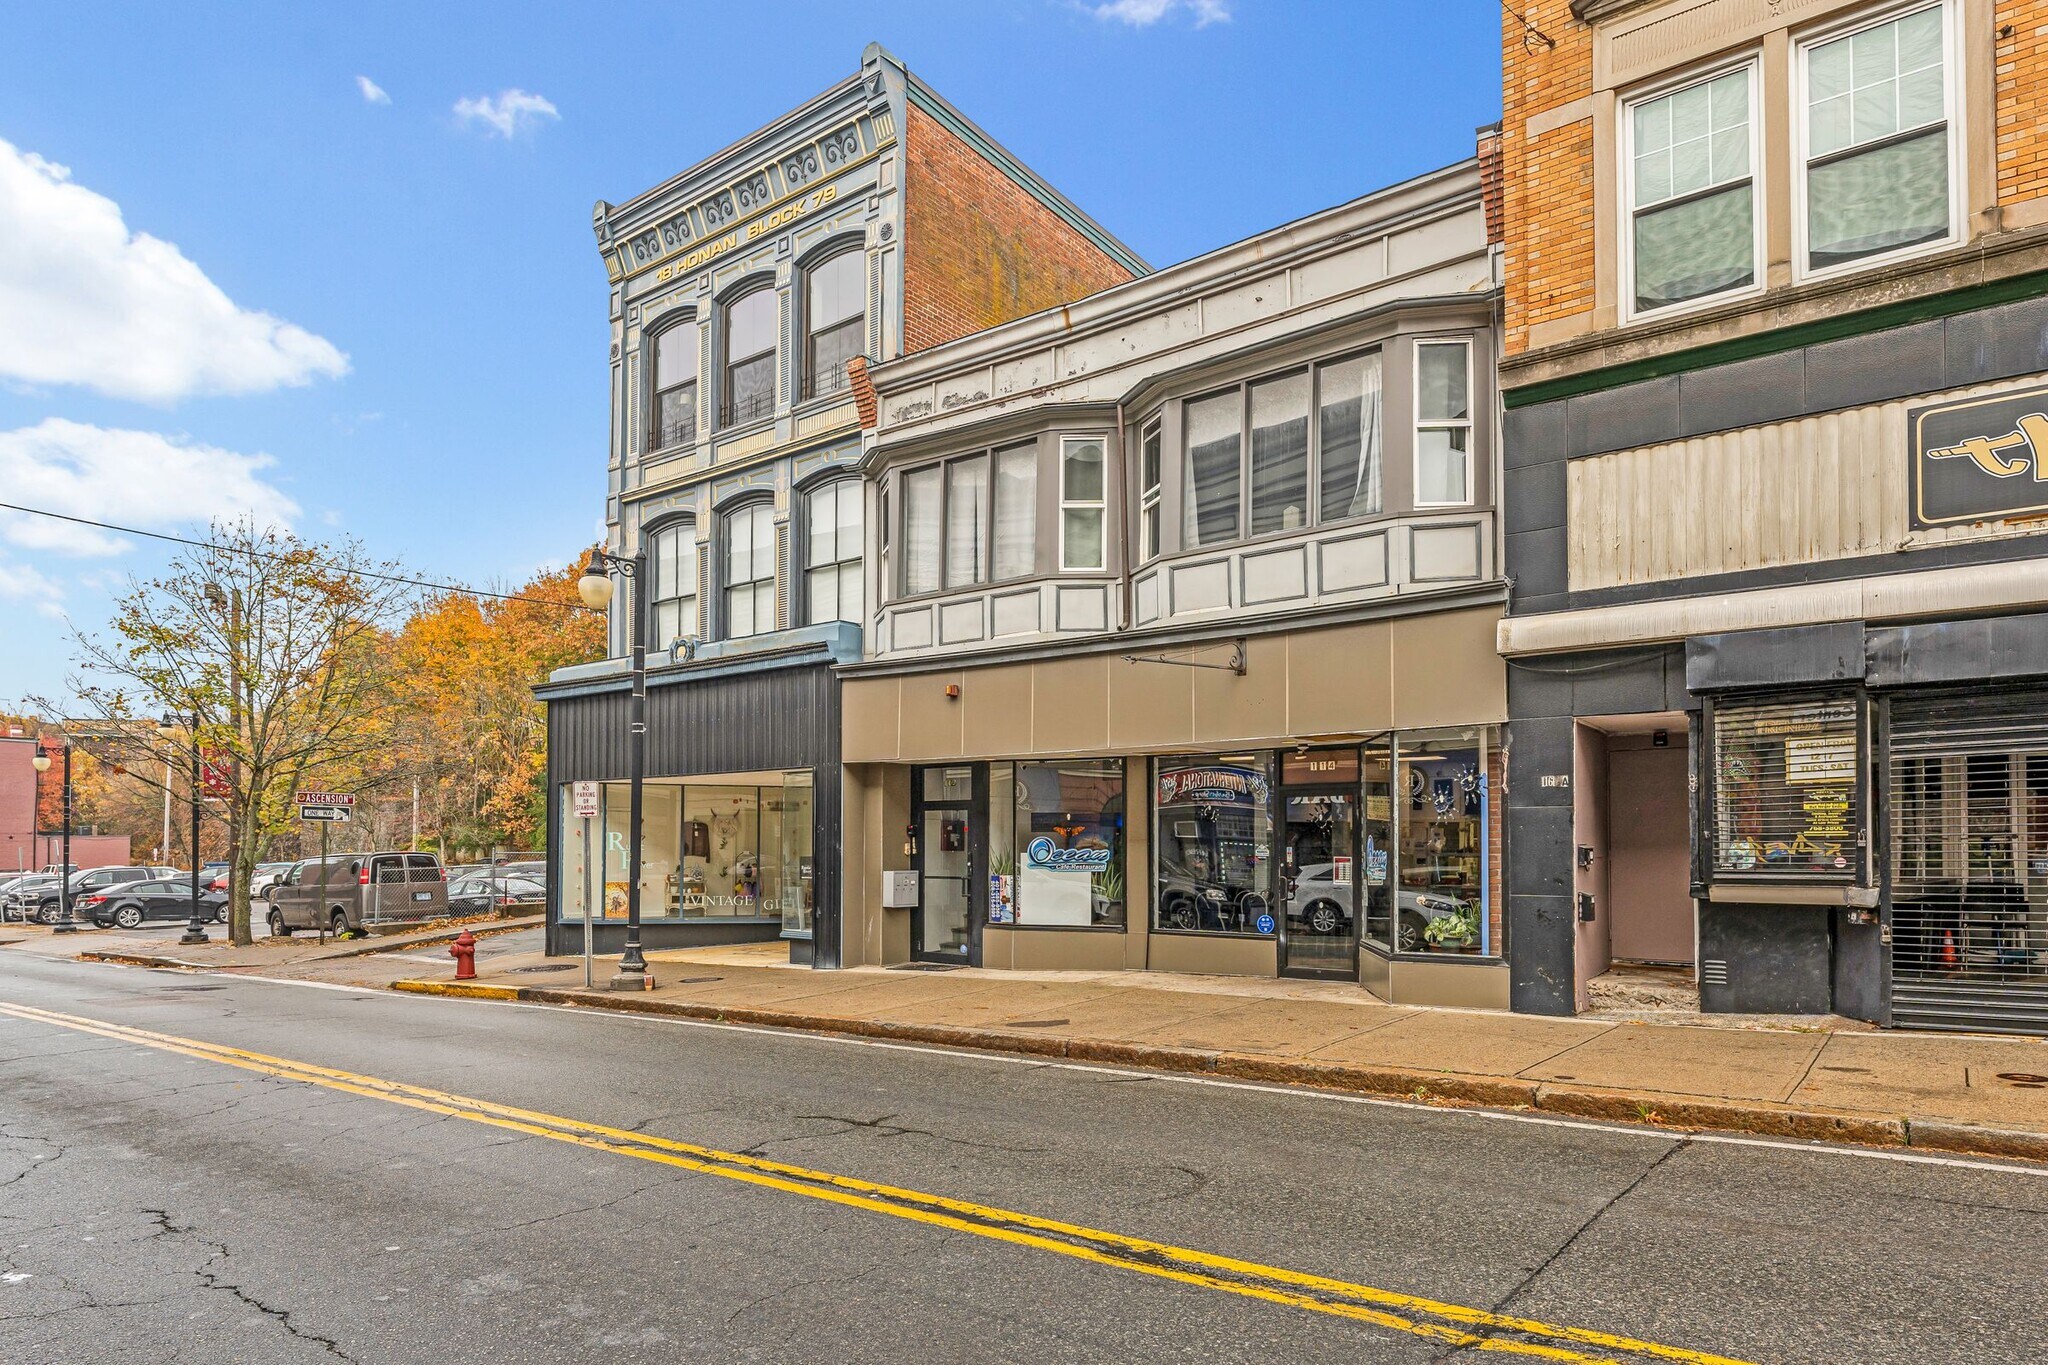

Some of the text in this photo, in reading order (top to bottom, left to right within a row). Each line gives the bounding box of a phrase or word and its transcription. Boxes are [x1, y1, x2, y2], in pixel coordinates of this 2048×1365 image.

[656, 184, 837, 282] 18 HONAN BLOCK 79
[1796, 741, 1824, 750] OPEN
[1310, 761, 1335, 771] 114
[306, 793, 349, 803] ASCENSION
[1028, 837, 1109, 864] Ocean
[691, 895, 754, 906] VINTAGE
